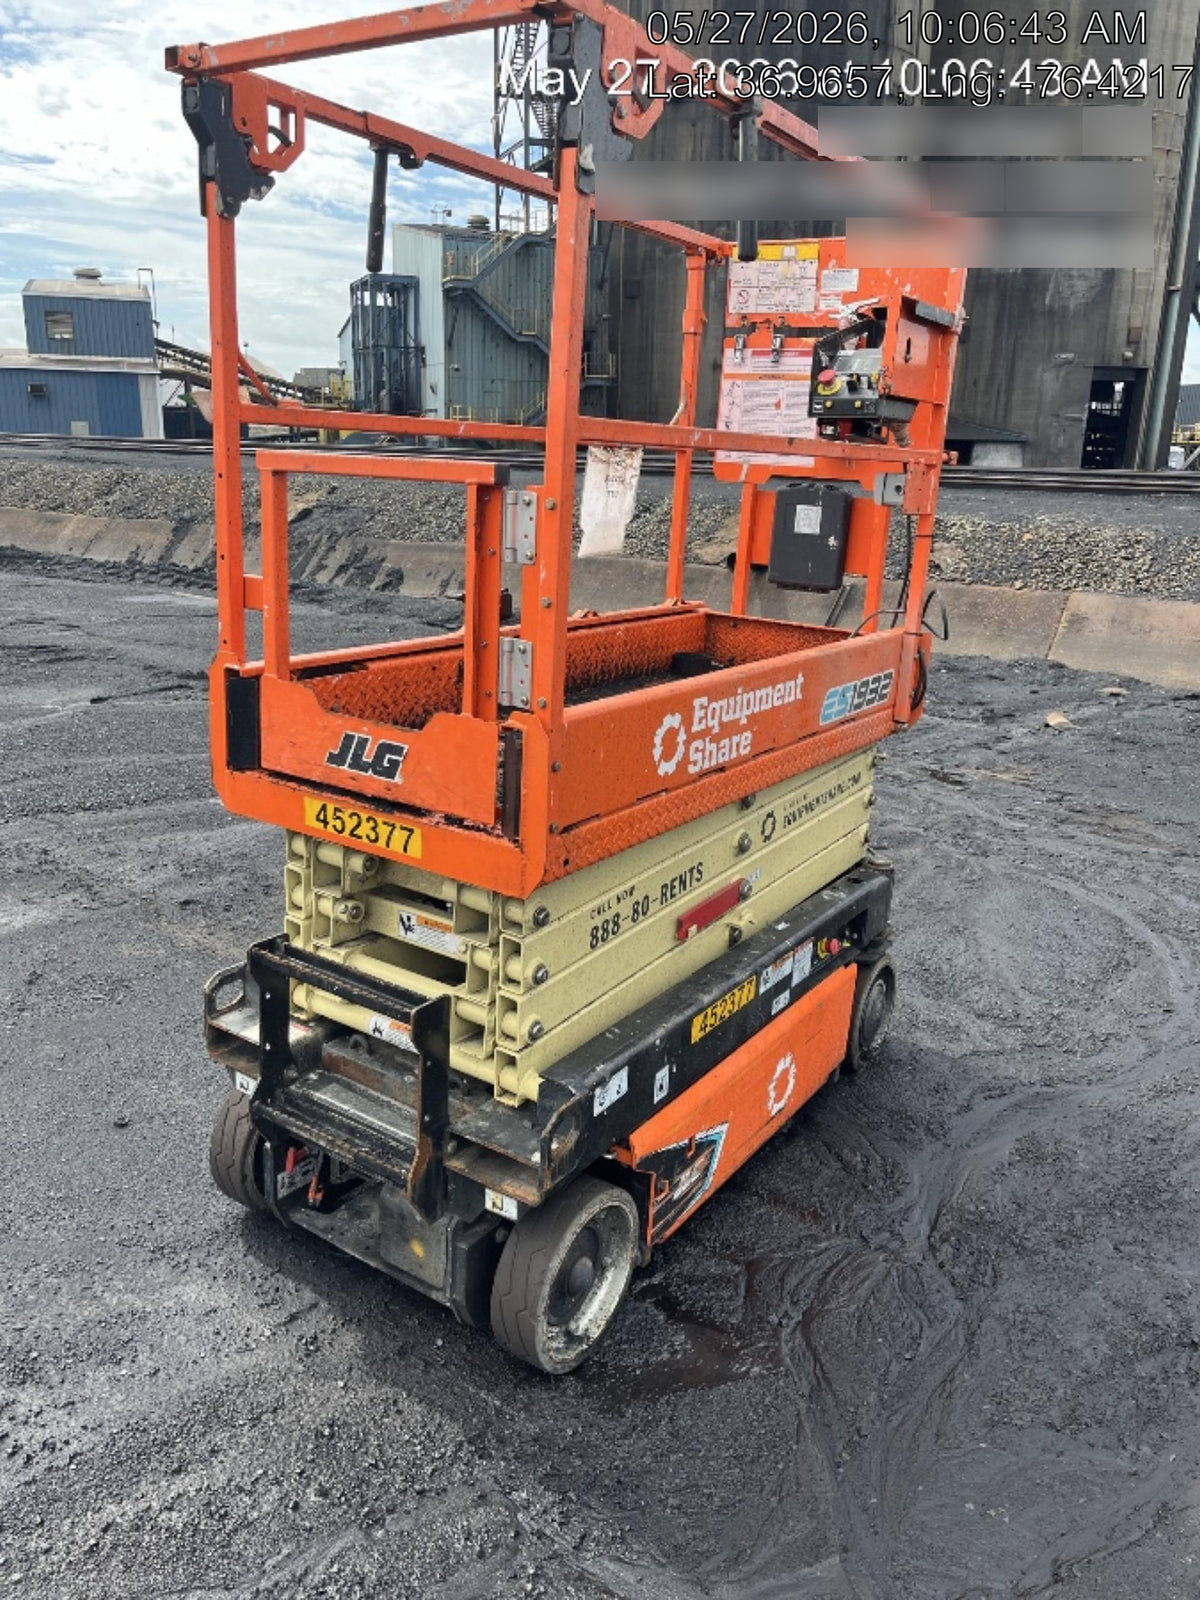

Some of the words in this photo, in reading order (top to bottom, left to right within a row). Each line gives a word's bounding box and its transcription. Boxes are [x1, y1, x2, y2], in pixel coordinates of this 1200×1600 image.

[691, 673, 804, 734] Equipment
[820, 669, 894, 725] ES1932
[325, 731, 409, 784] JLG
[687, 729, 753, 775] Share
[315, 802, 415, 854] 452377
[589, 861, 704, 949] 888-80-RENTS
[616, 884, 637, 904] NOW
[699, 976, 754, 1034] 452377
